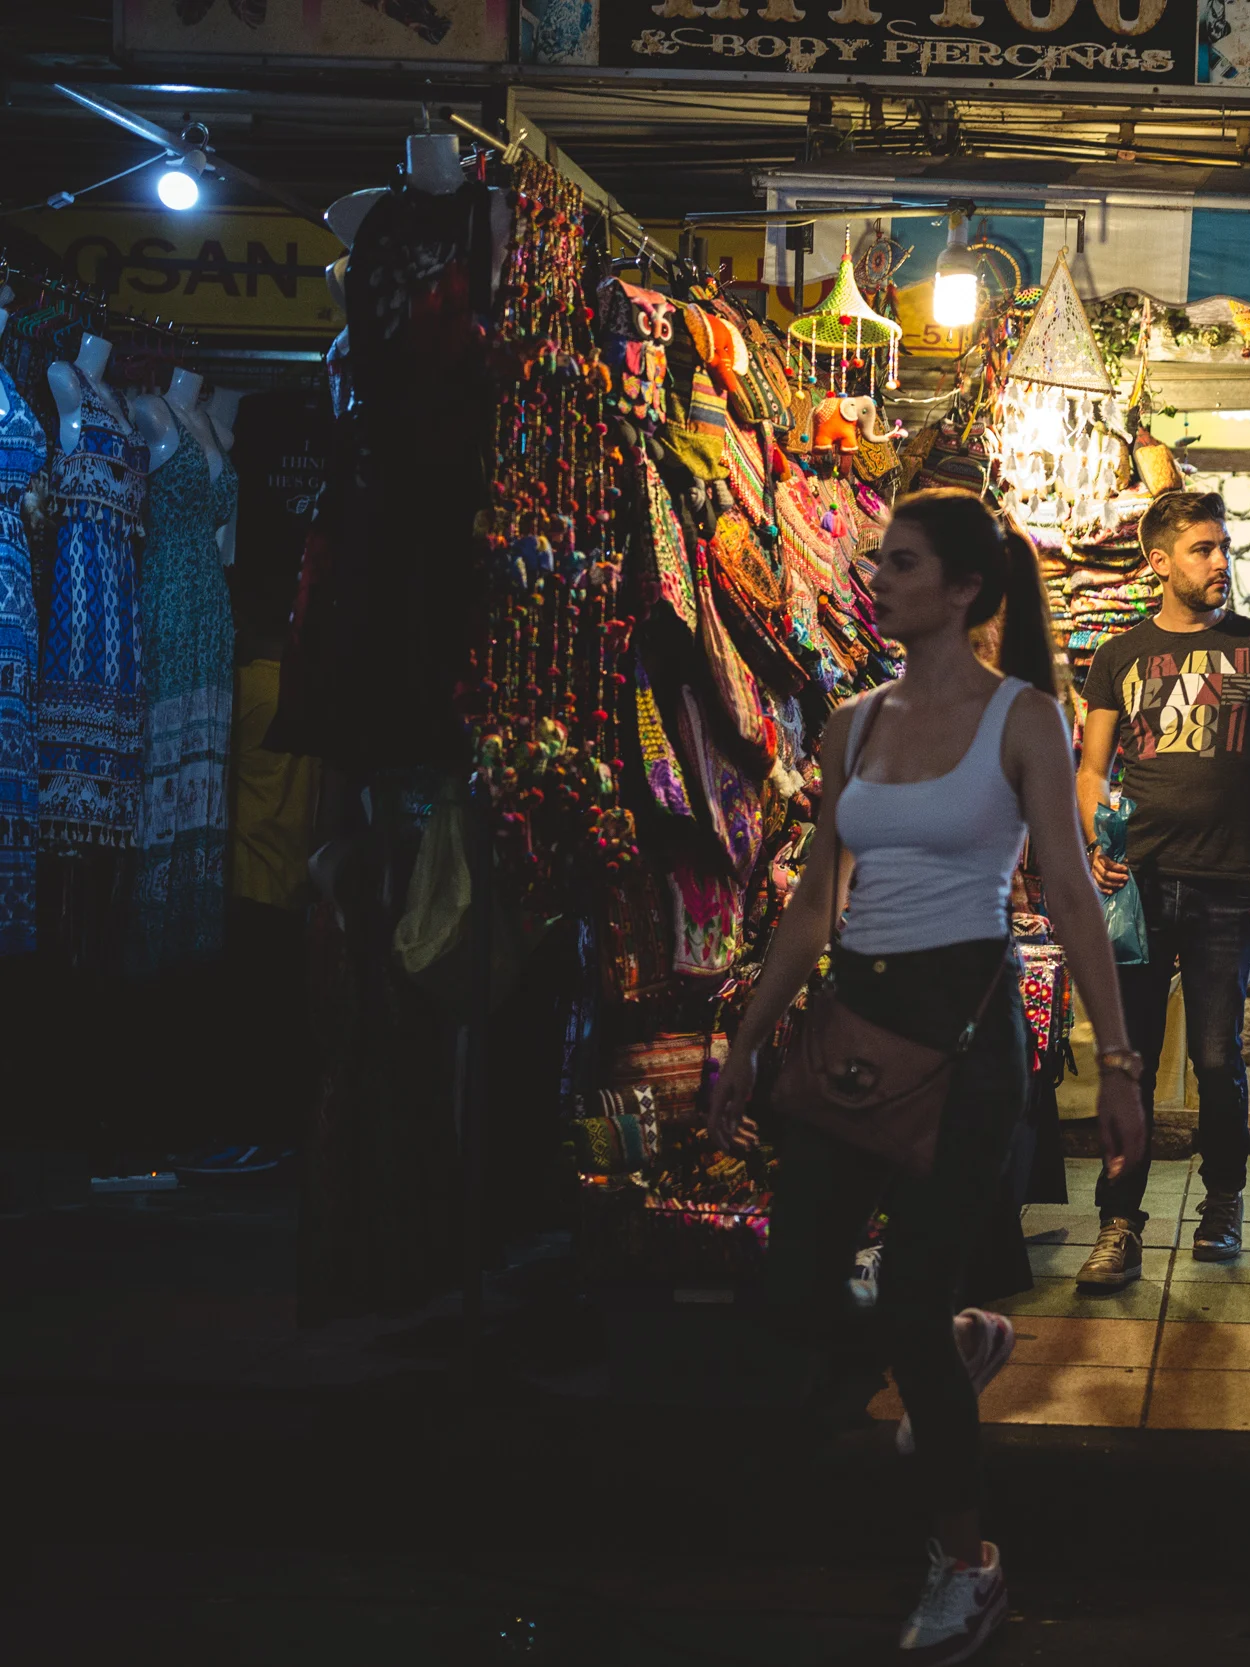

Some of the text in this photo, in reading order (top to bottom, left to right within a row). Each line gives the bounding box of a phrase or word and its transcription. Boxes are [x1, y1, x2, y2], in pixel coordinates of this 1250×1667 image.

[631, 22, 1175, 80] & BODY PIERCINGS
[282, 456, 325, 469] THIN
[1122, 647, 1250, 684] ARMANI
